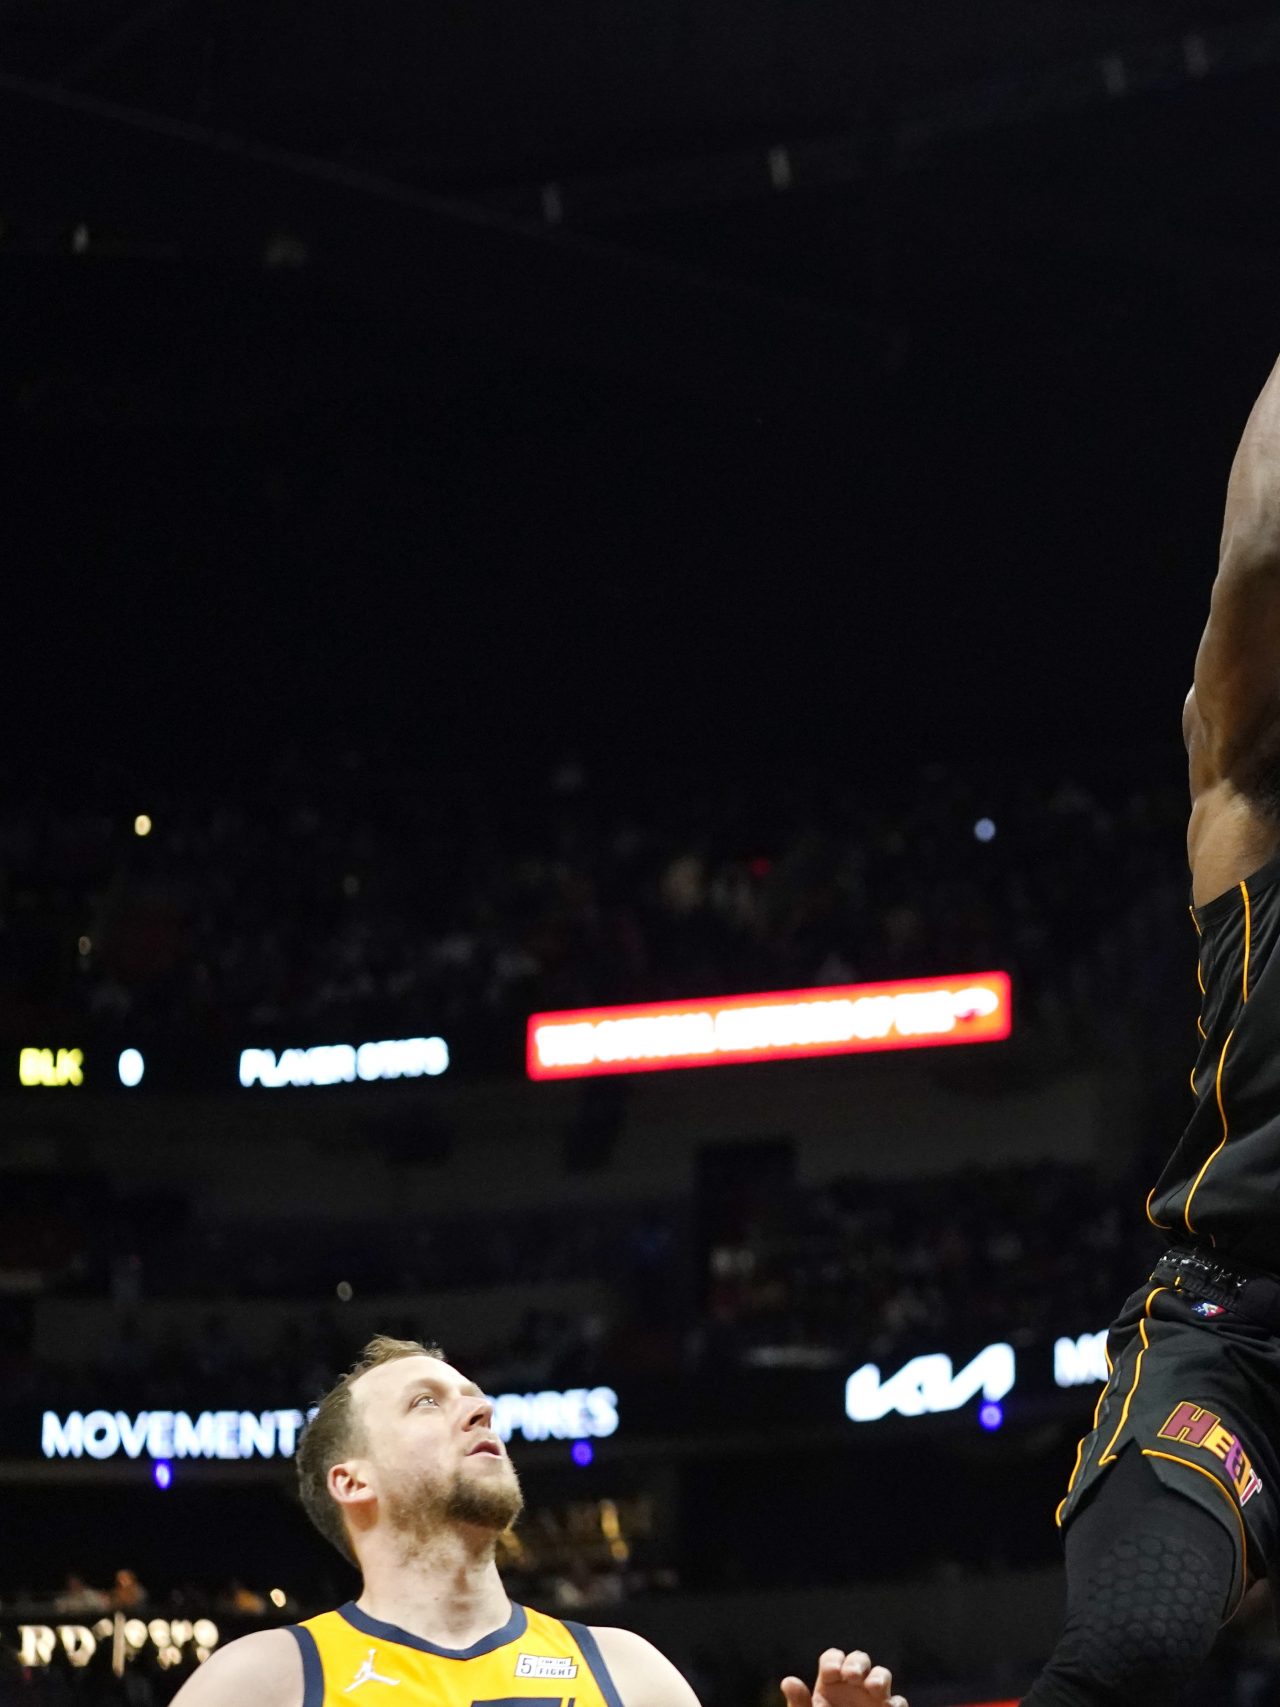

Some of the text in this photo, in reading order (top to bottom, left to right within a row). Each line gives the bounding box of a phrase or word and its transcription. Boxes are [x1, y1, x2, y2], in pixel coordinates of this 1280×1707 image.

[41, 1409, 302, 1460] MOVEMENT
[1156, 1400, 1263, 1508] HEAT
[520, 1657, 533, 1675] 5
[539, 1667, 573, 1676] FIGHT
